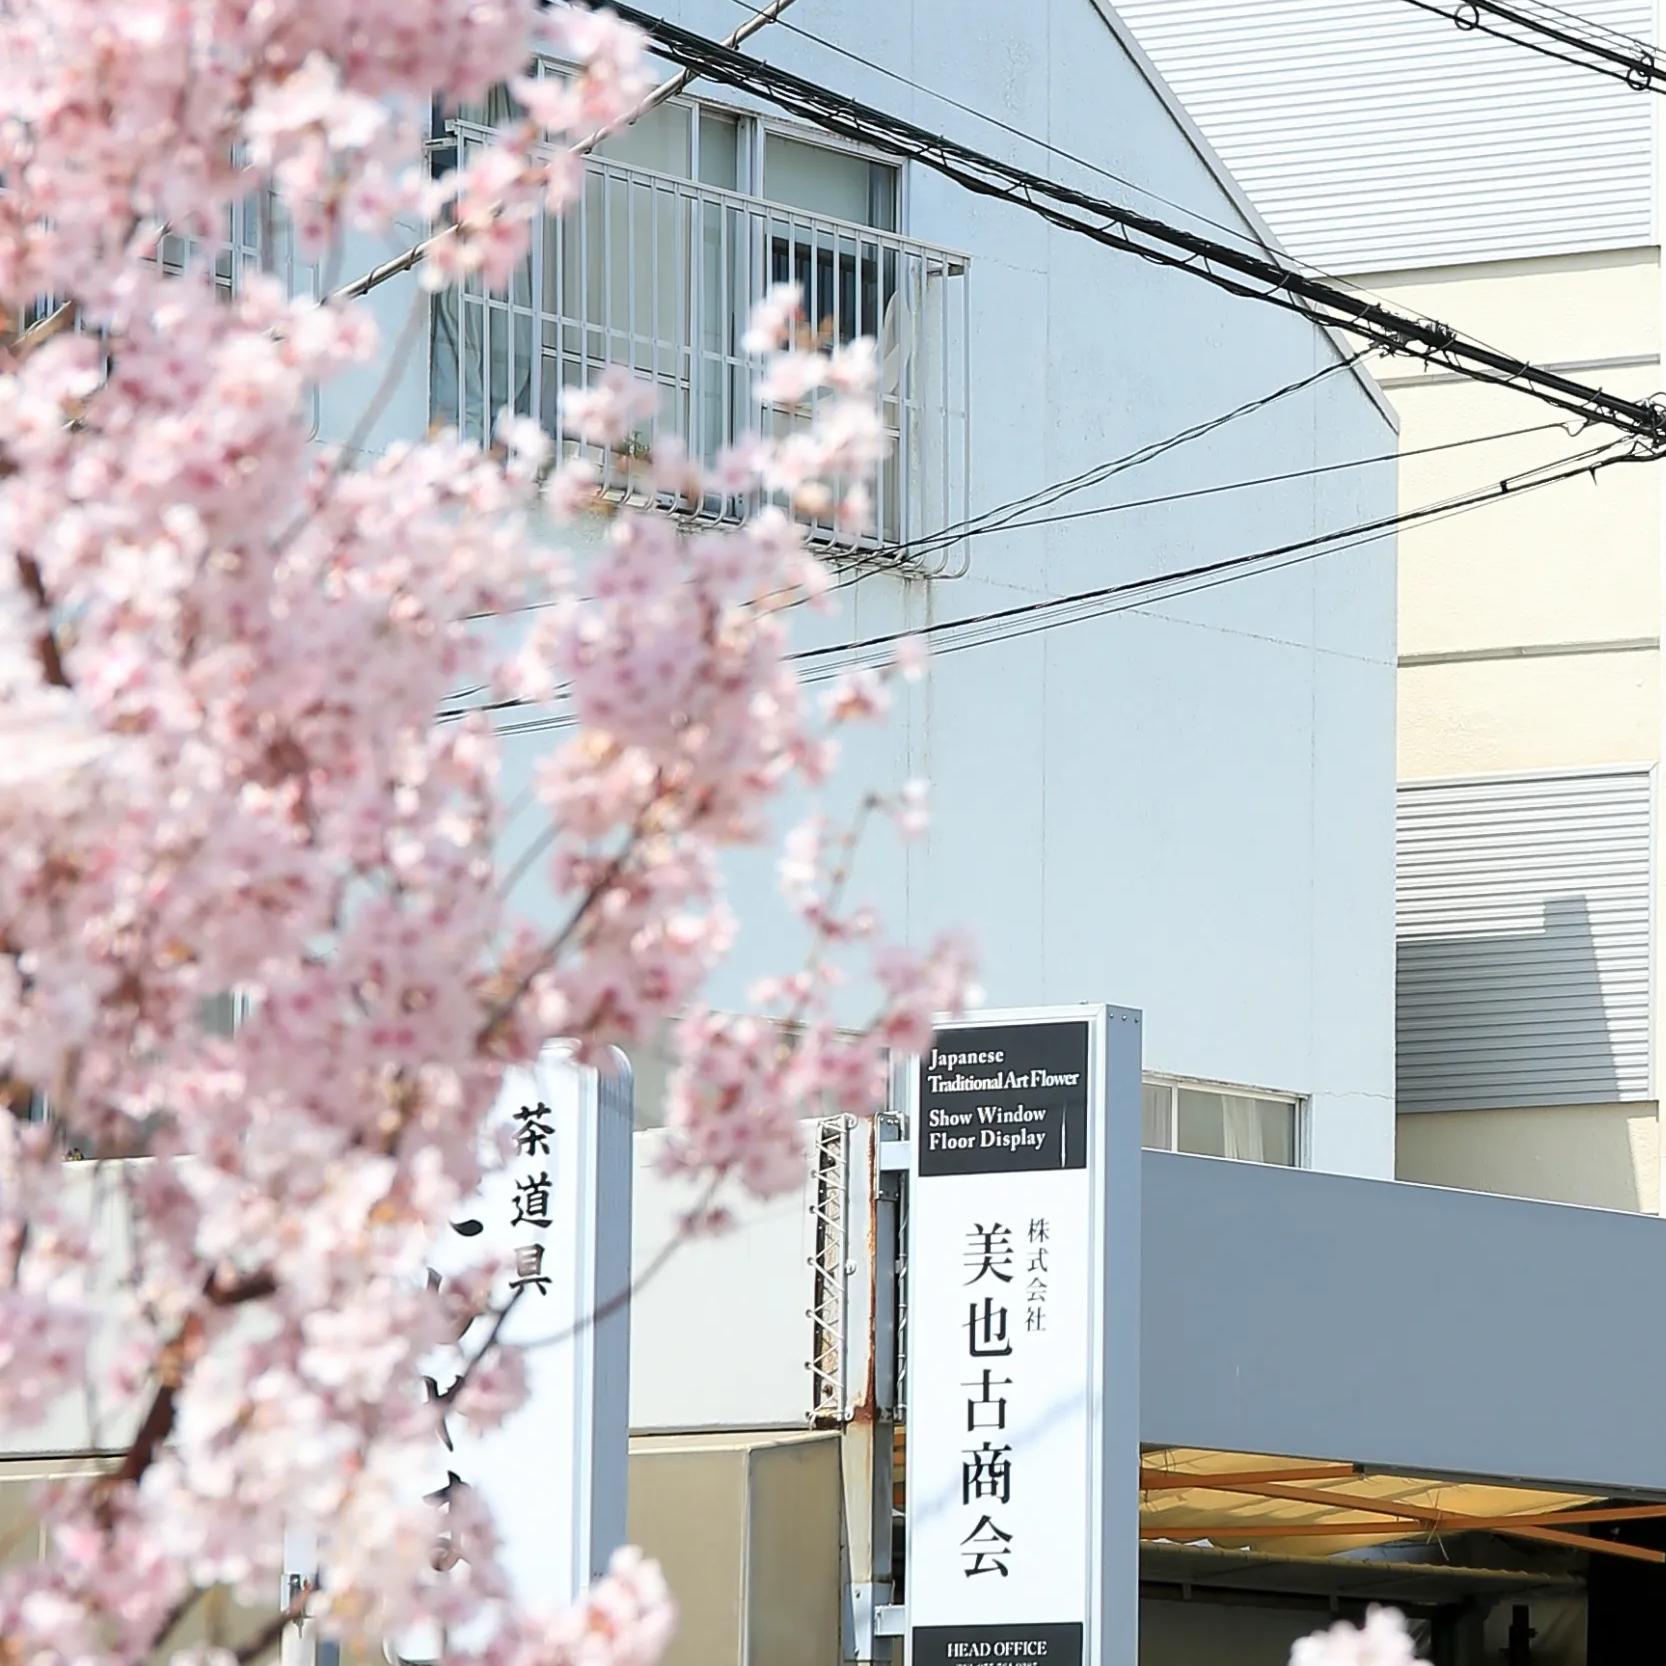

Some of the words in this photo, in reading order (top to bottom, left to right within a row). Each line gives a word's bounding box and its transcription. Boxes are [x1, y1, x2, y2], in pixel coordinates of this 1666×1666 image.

[928, 1049, 1004, 1071] Japanese
[928, 1072, 1005, 1093] Traditional
[1004, 1071, 1030, 1090] Art
[1031, 1069, 1080, 1088] Flower
[929, 1109, 973, 1127] Show
[977, 1104, 1046, 1124] Window
[929, 1132, 976, 1151] Floor
[980, 1128, 1046, 1152] Display
[508, 1102, 556, 1296] 茶道具
[1024, 1218, 1050, 1332] 株式会社
[960, 1222, 1015, 1578] 美也古商会
[947, 1642, 992, 1658] HEAD
[993, 1641, 1048, 1656] OFFICE
